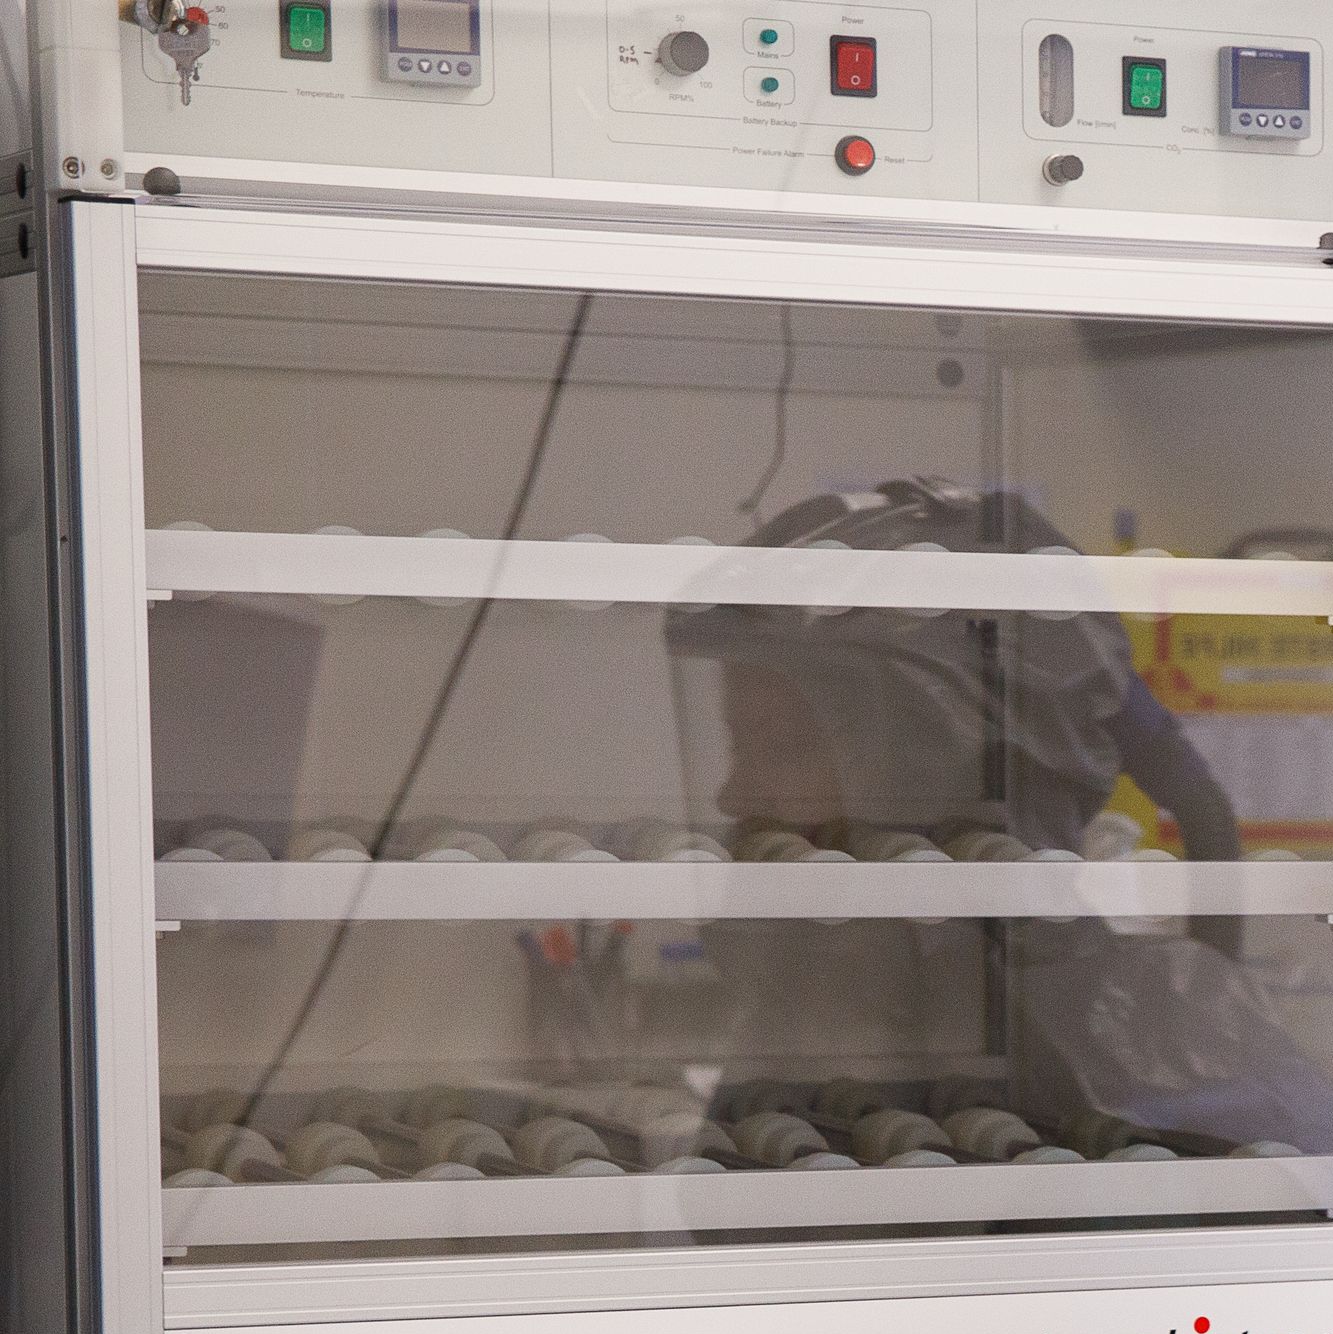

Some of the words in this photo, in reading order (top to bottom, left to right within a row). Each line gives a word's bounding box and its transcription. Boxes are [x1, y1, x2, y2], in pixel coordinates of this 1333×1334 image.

[841, 15, 864, 24] Power
[757, 51, 779, 59] Mains
[700, 81, 713, 89] 100
[295, 88, 345, 100] Temperature
[668, 93, 694, 102] RPM%
[756, 99, 782, 109] Battery
[743, 116, 769, 127] Battery
[770, 118, 798, 128] Backup
[732, 146, 756, 155] Power
[757, 148, 782, 157] Failure
[783, 150, 805, 158] Alarm
[884, 156, 905, 164] Reset
